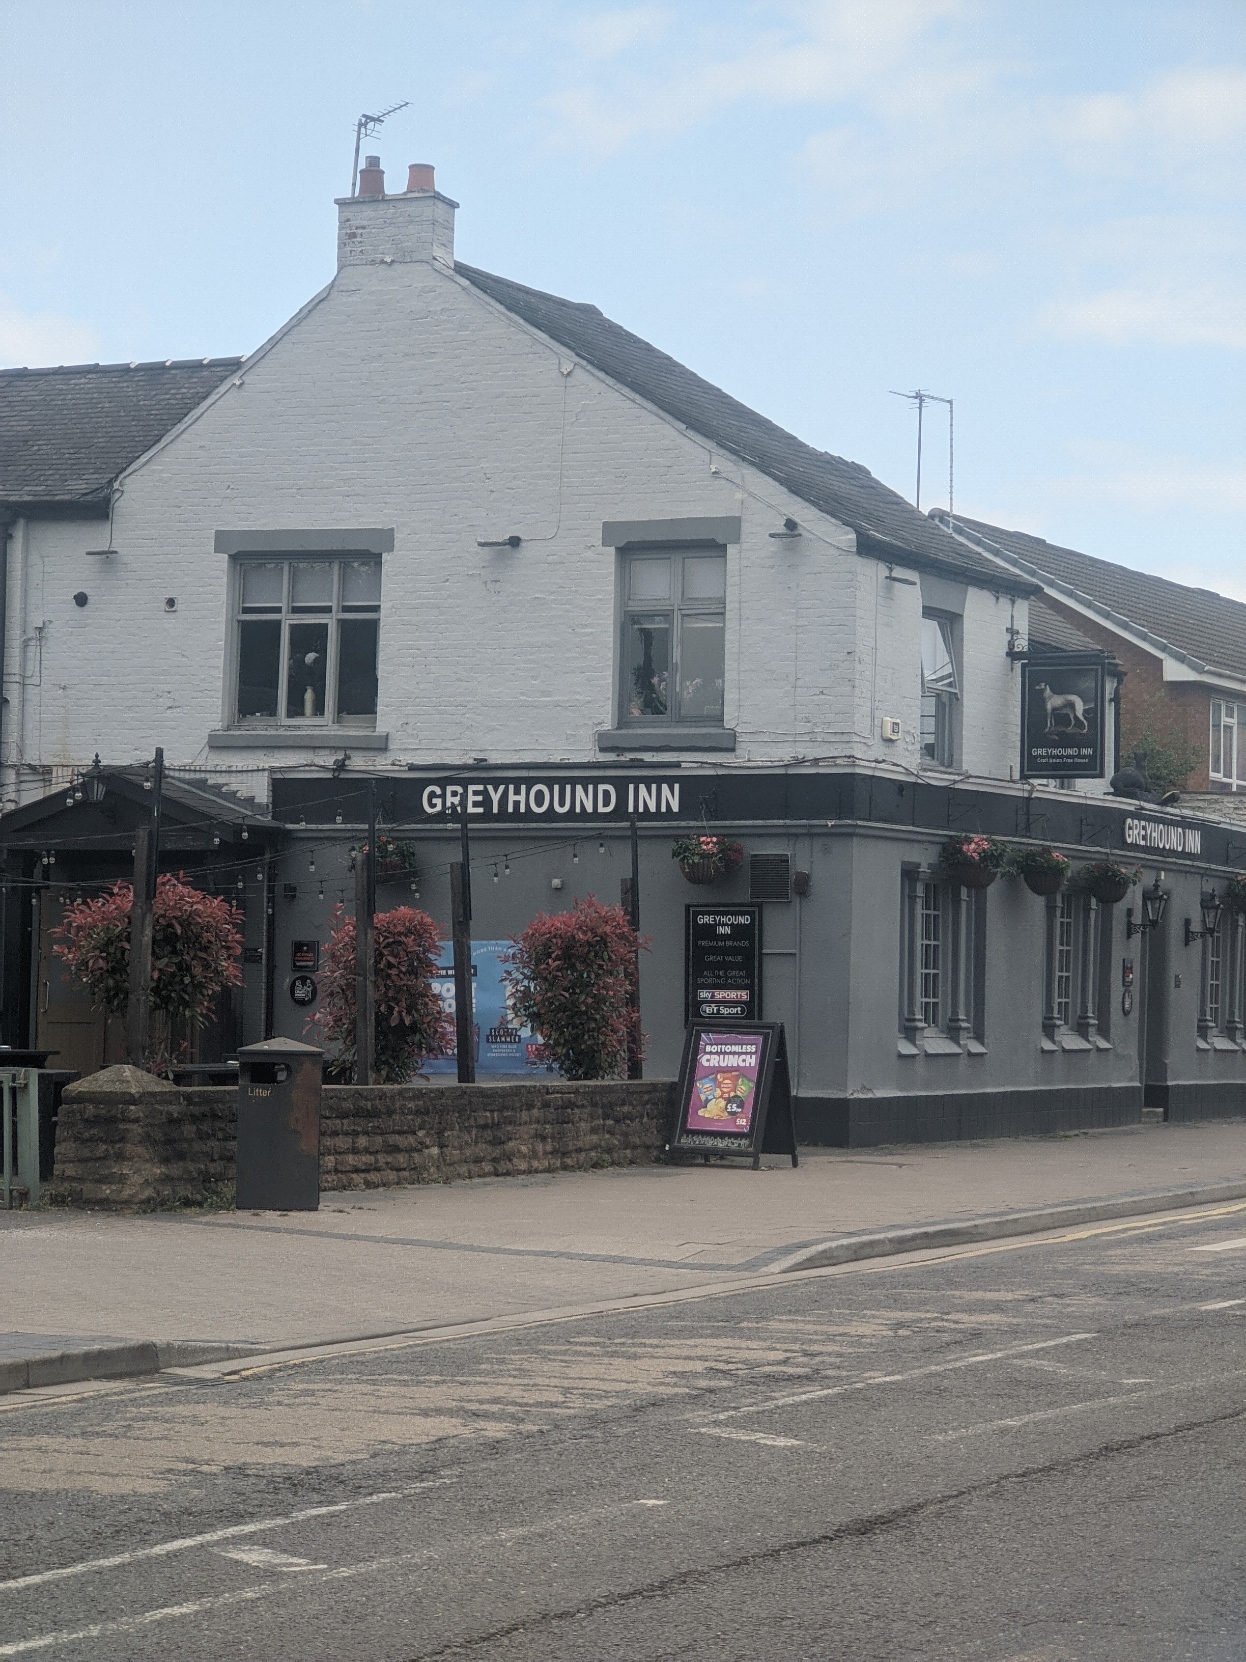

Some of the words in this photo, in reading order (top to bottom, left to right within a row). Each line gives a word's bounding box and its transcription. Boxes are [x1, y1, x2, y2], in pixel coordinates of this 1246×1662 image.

[1031, 747, 1079, 756] GREYHOUND
[1080, 747, 1093, 756] INN
[422, 783, 616, 814] GREYHOUND
[628, 783, 680, 813] INN
[1125, 817, 1184, 852] GREYHOUND
[1185, 828, 1201, 854] INN
[697, 915, 751, 924] GREYHOUND
[716, 925, 731, 935] INN
[699, 990, 712, 999] sky
[714, 991, 748, 999] SPORTS
[706, 1006, 719, 1014] BT
[719, 1006, 742, 1015] Sport
[488, 1035, 519, 1043] SLAMMER
[705, 1044, 756, 1053] BOTTOMLESS
[701, 1054, 756, 1067] CRUNCH
[248, 1086, 271, 1097] Litter
[735, 1118, 747, 1126] £12
